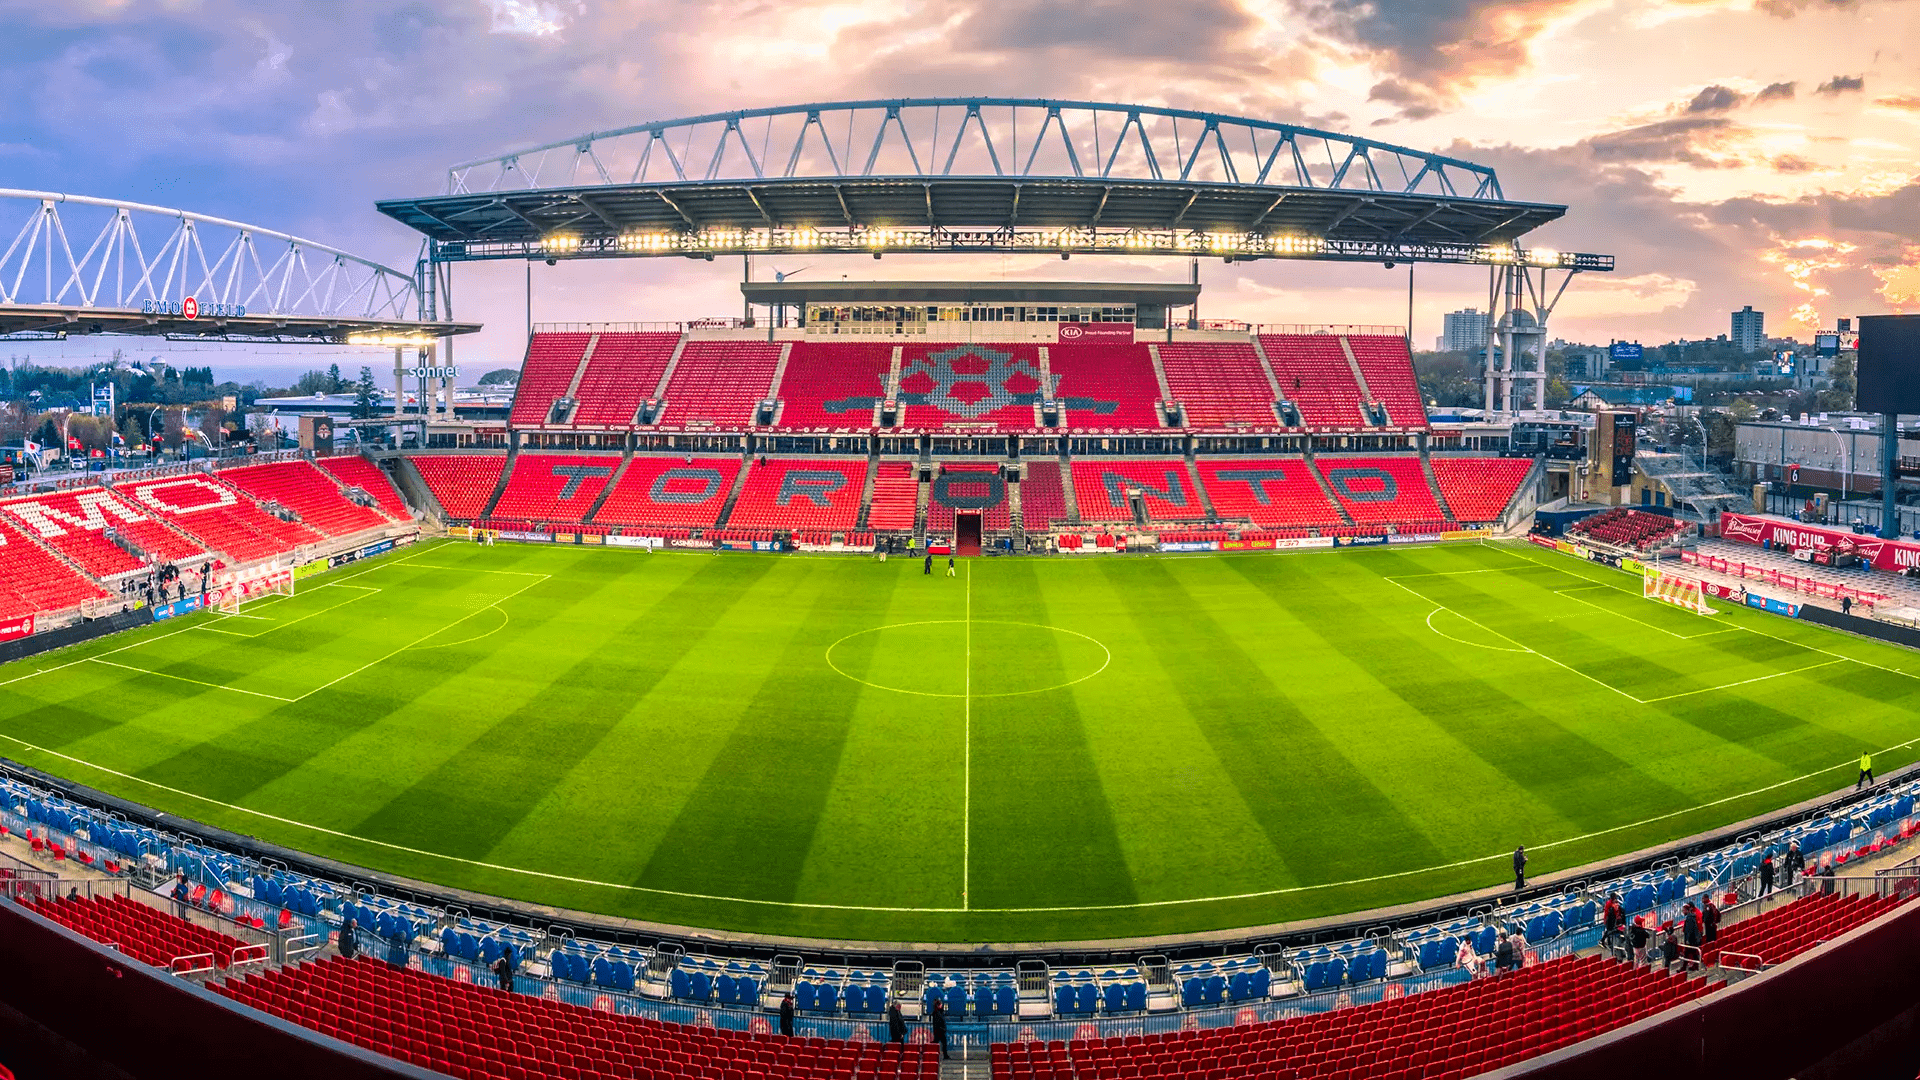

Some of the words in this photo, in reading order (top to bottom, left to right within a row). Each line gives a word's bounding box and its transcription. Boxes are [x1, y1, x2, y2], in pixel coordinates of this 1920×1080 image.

[144, 299, 180, 315] BMO
[199, 301, 246, 317] FIELD
[1063, 328, 1080, 337] KIA
[408, 366, 460, 378] sonnet
[1792, 469, 1799, 482] 6
[551, 465, 1398, 508] TORONTO
[0, 479, 238, 545] MO
[1727, 520, 1763, 536] Budweiser
[1773, 527, 1797, 546] KING
